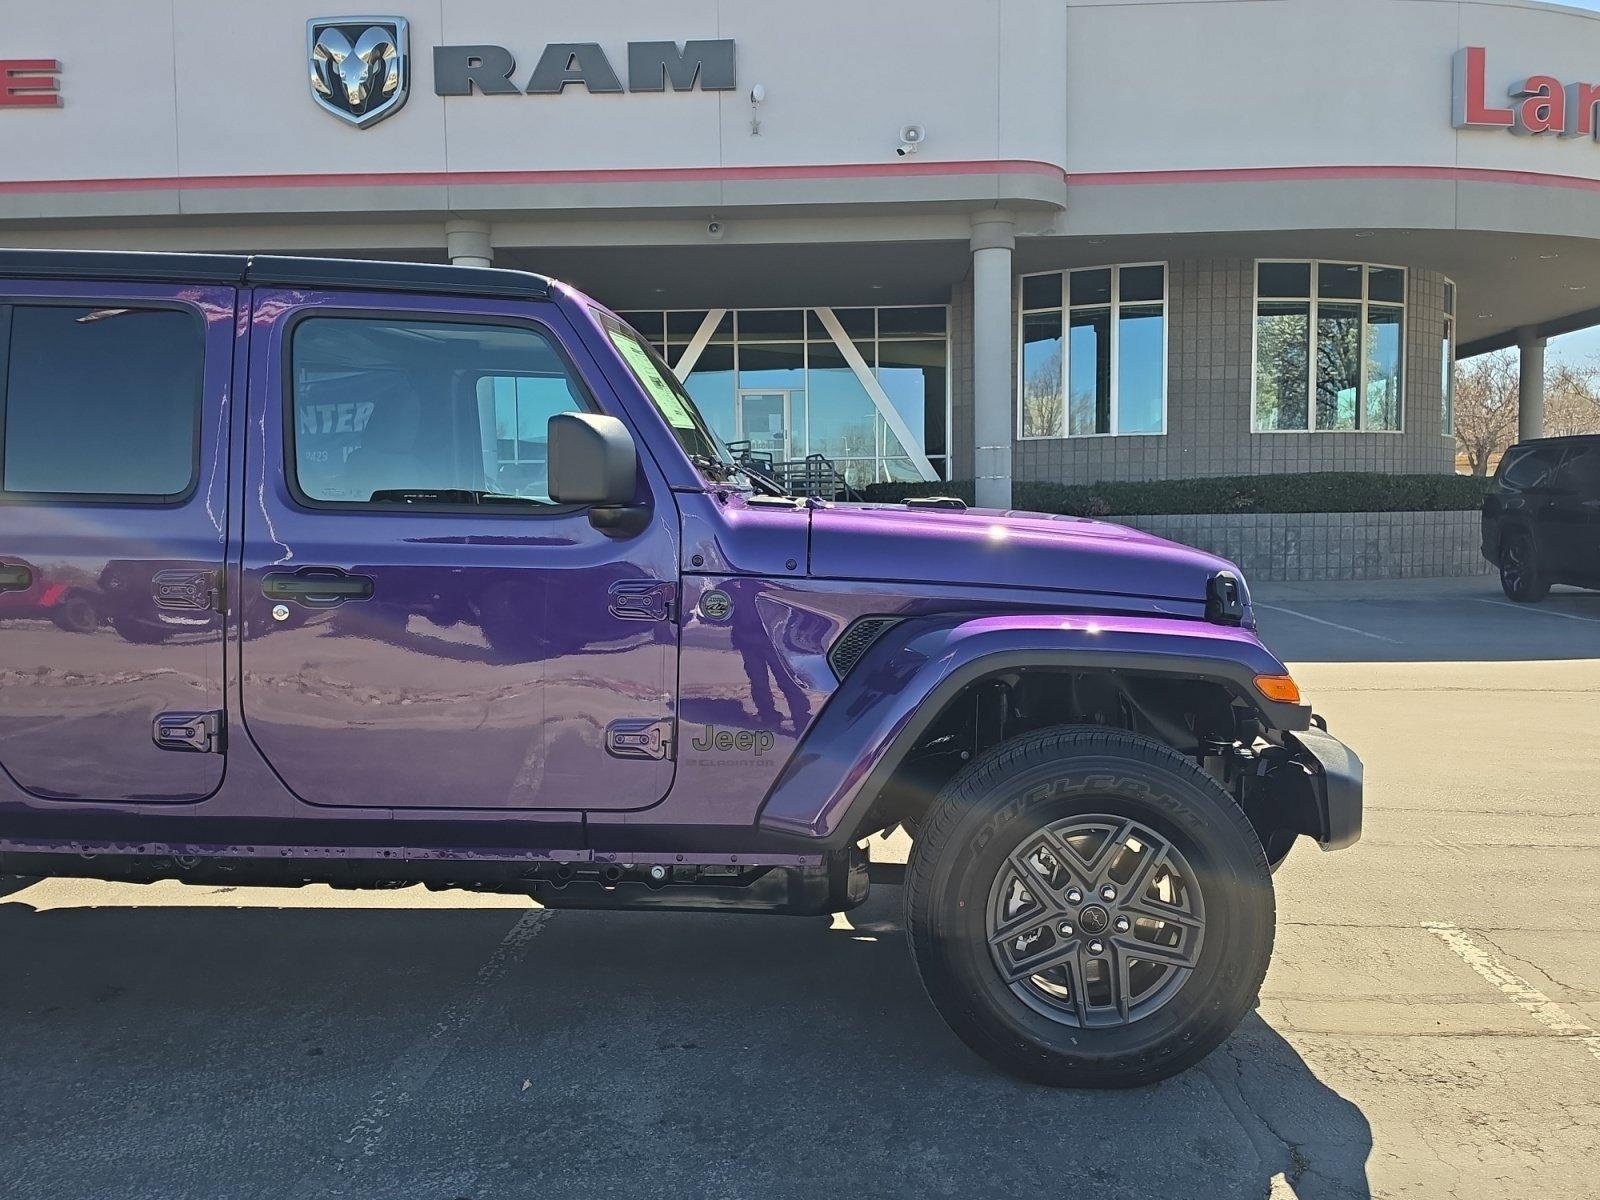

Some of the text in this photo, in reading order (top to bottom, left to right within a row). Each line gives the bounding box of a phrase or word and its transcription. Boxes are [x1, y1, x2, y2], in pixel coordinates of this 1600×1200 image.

[0, 58, 64, 109] E
[432, 38, 737, 97] RAM
[691, 724, 775, 756] Jeep
